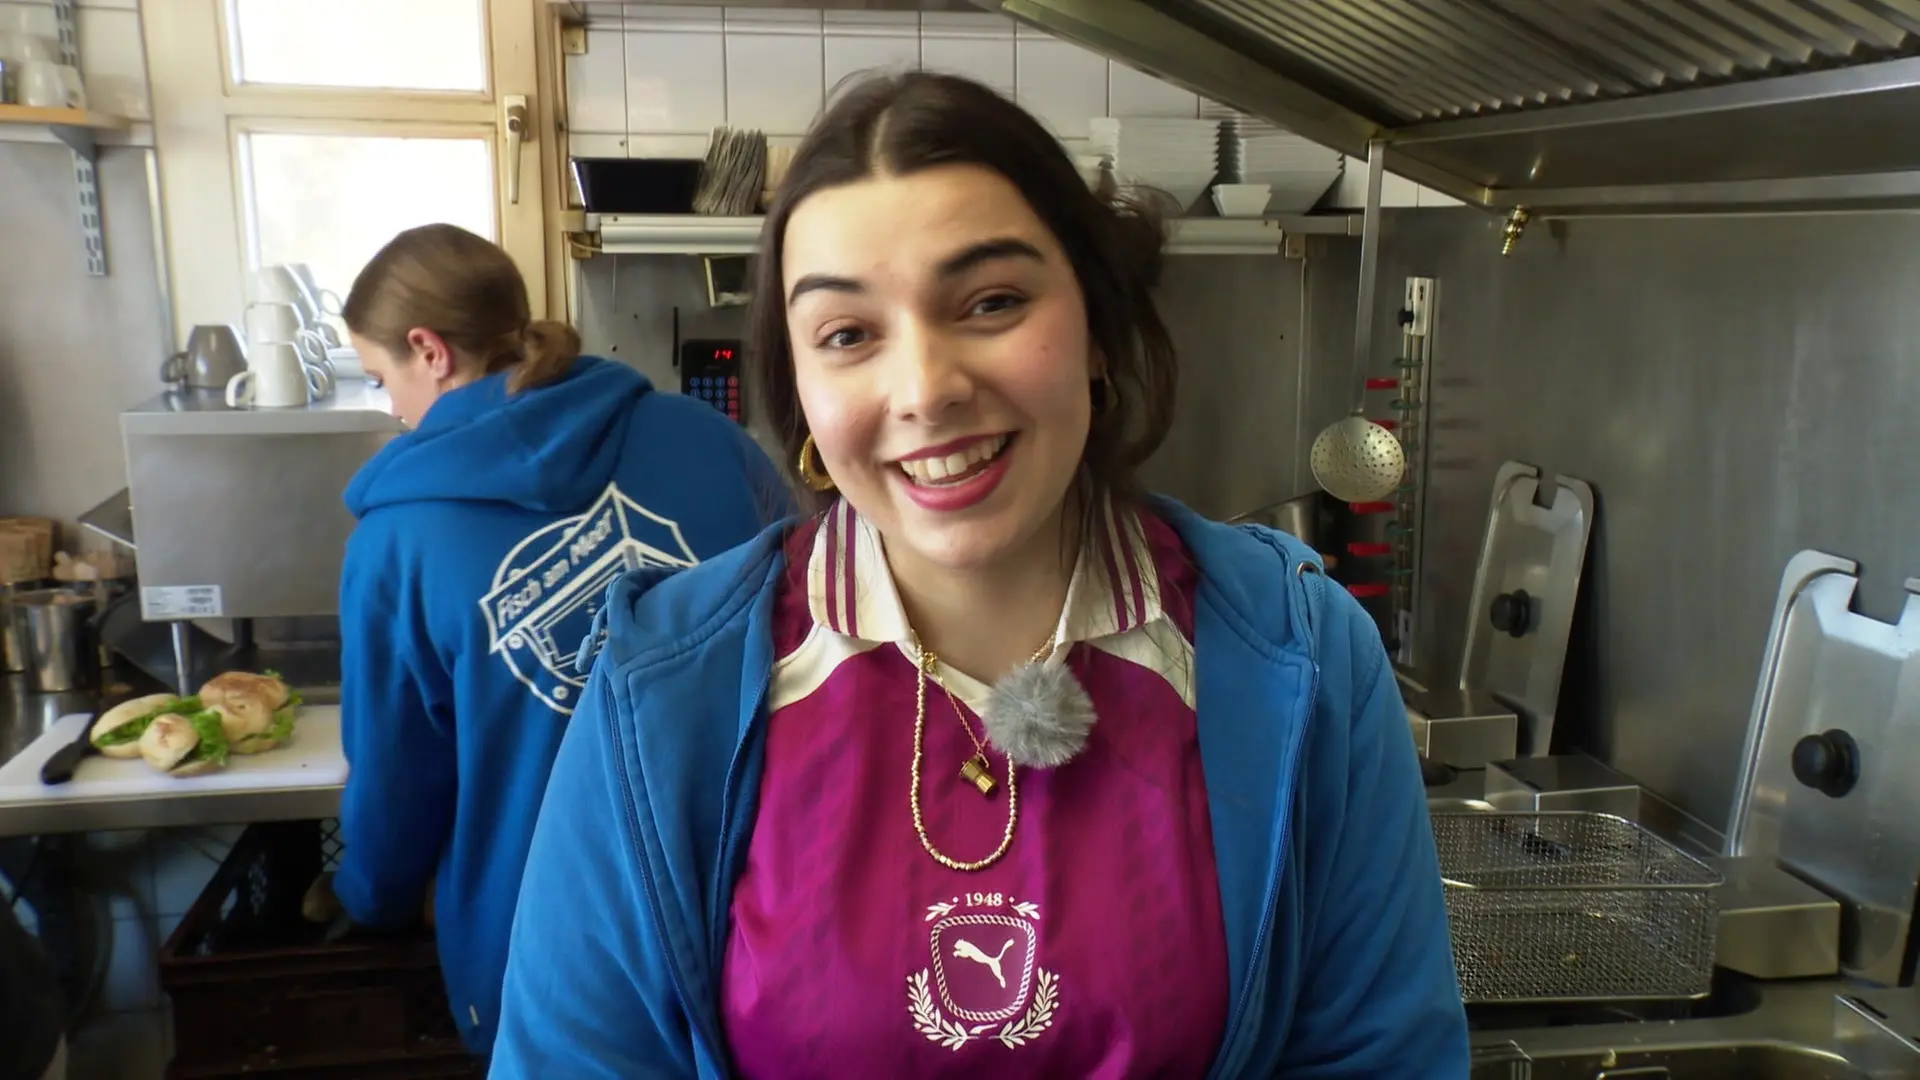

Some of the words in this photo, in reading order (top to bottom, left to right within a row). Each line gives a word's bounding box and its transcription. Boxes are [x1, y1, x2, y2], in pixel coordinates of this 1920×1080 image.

[498, 580, 541, 628] Fisch
[544, 559, 569, 587] am
[966, 892, 1003, 907] 1948
